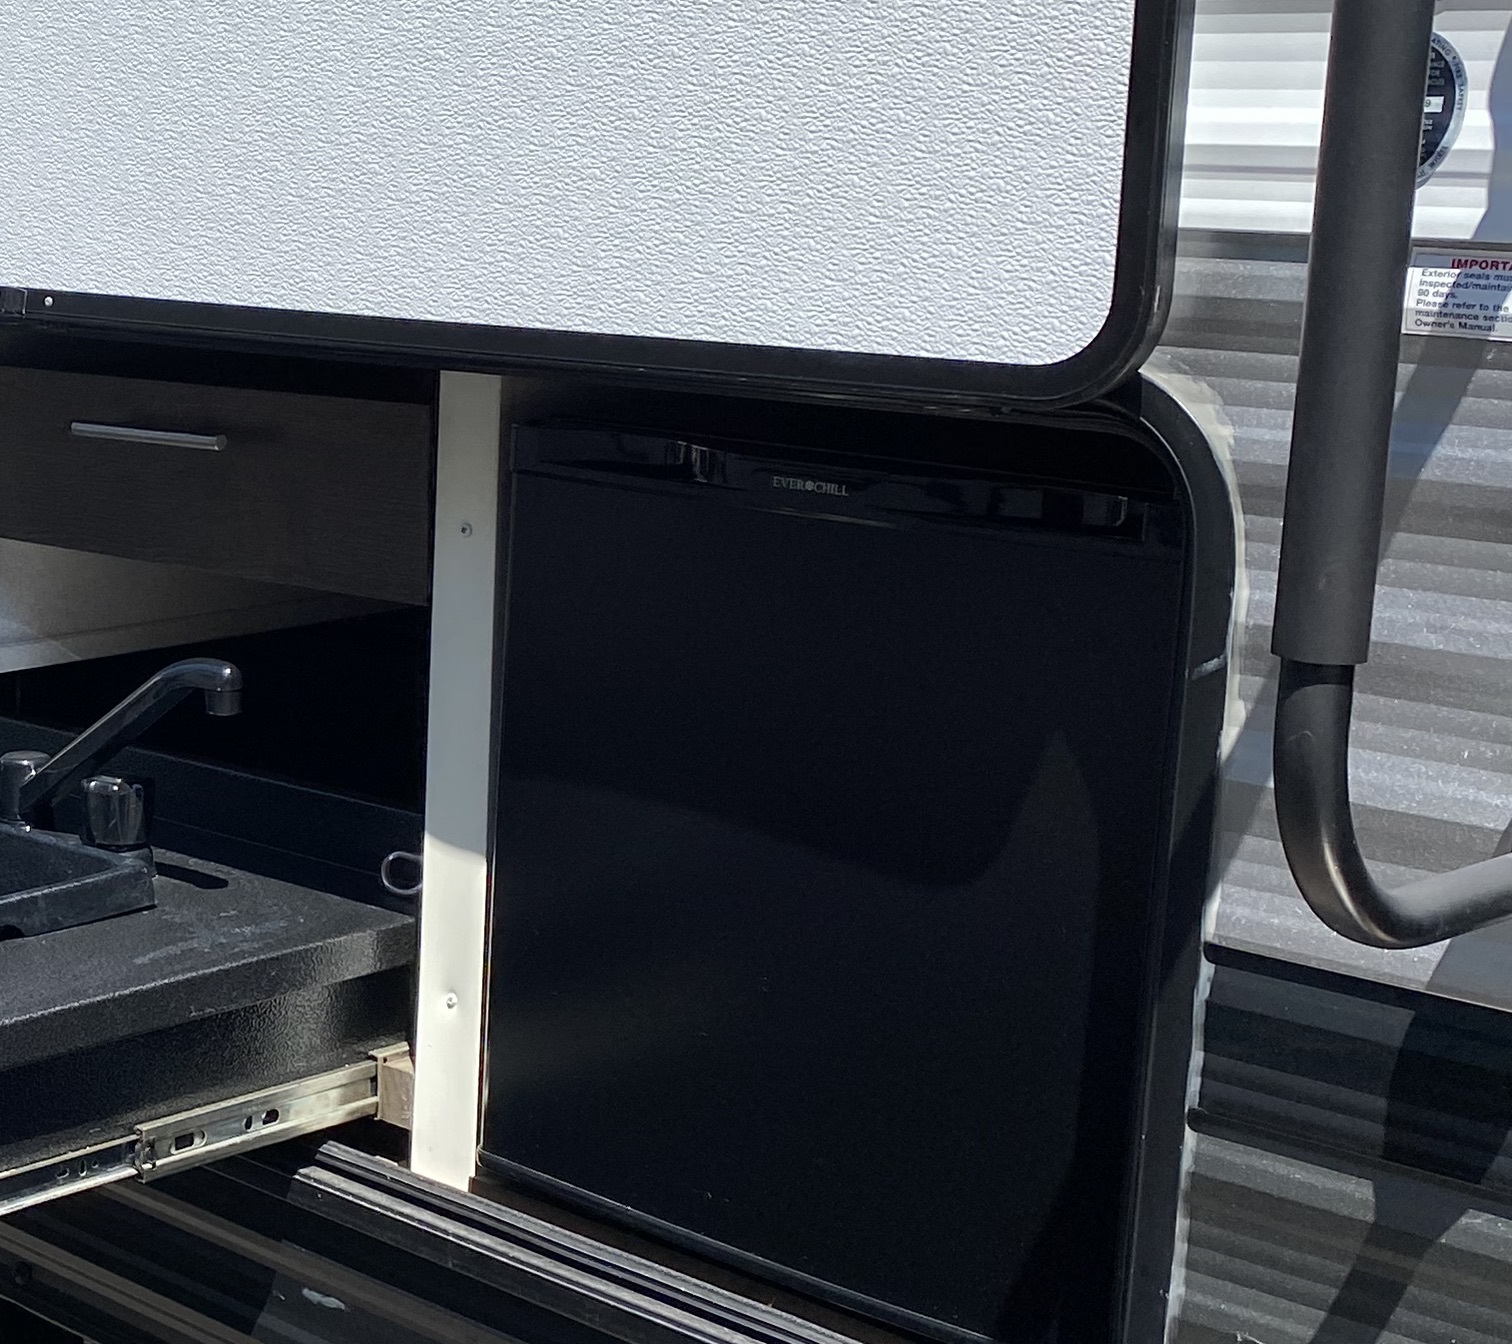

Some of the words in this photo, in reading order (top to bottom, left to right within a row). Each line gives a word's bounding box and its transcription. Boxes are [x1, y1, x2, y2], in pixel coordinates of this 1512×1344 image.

[1451, 258, 1512, 272] IMPORT
[1421, 268, 1462, 279] Exterior
[1416, 298, 1449, 308] Please
[1452, 301, 1477, 311] refer
[1479, 303, 1489, 312] to
[1493, 304, 1509, 313] the
[1415, 309, 1479, 321] maintenance
[1483, 313, 1512, 323] sectio
[1415, 318, 1455, 329] Owner's
